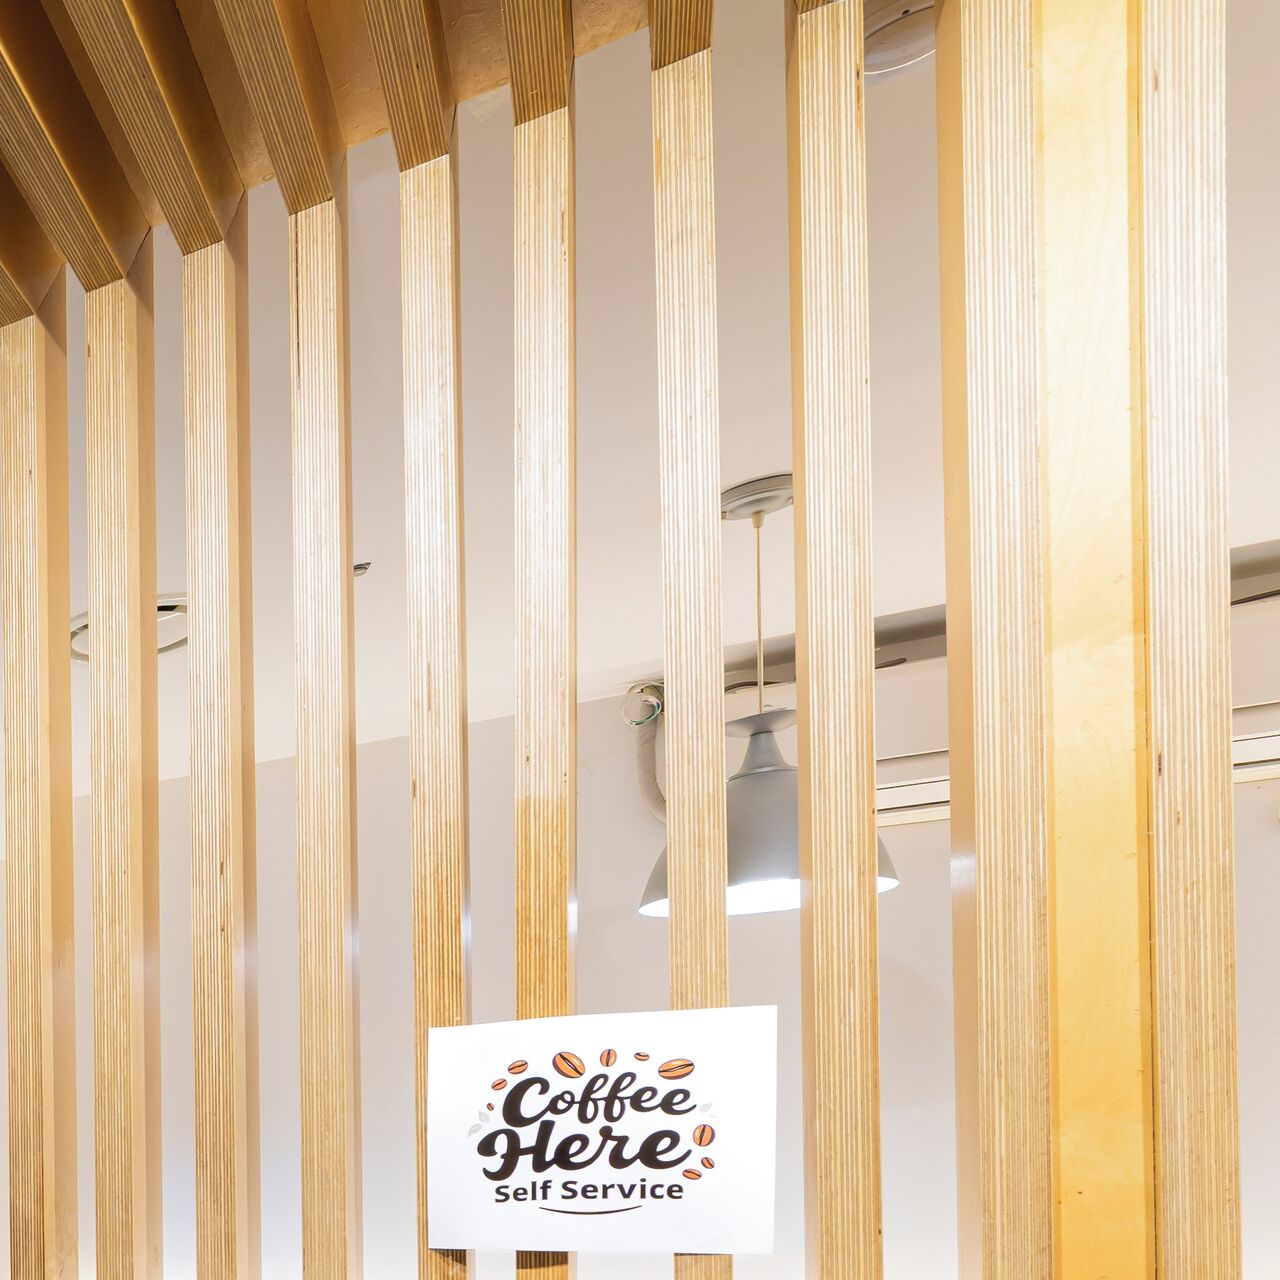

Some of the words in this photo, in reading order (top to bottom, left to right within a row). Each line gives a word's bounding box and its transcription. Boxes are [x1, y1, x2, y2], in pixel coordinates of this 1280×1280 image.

[502, 1071, 697, 1128] Coffee
[477, 1119, 692, 1181] Here
[494, 1180, 553, 1203] Self
[561, 1178, 684, 1200] Service
